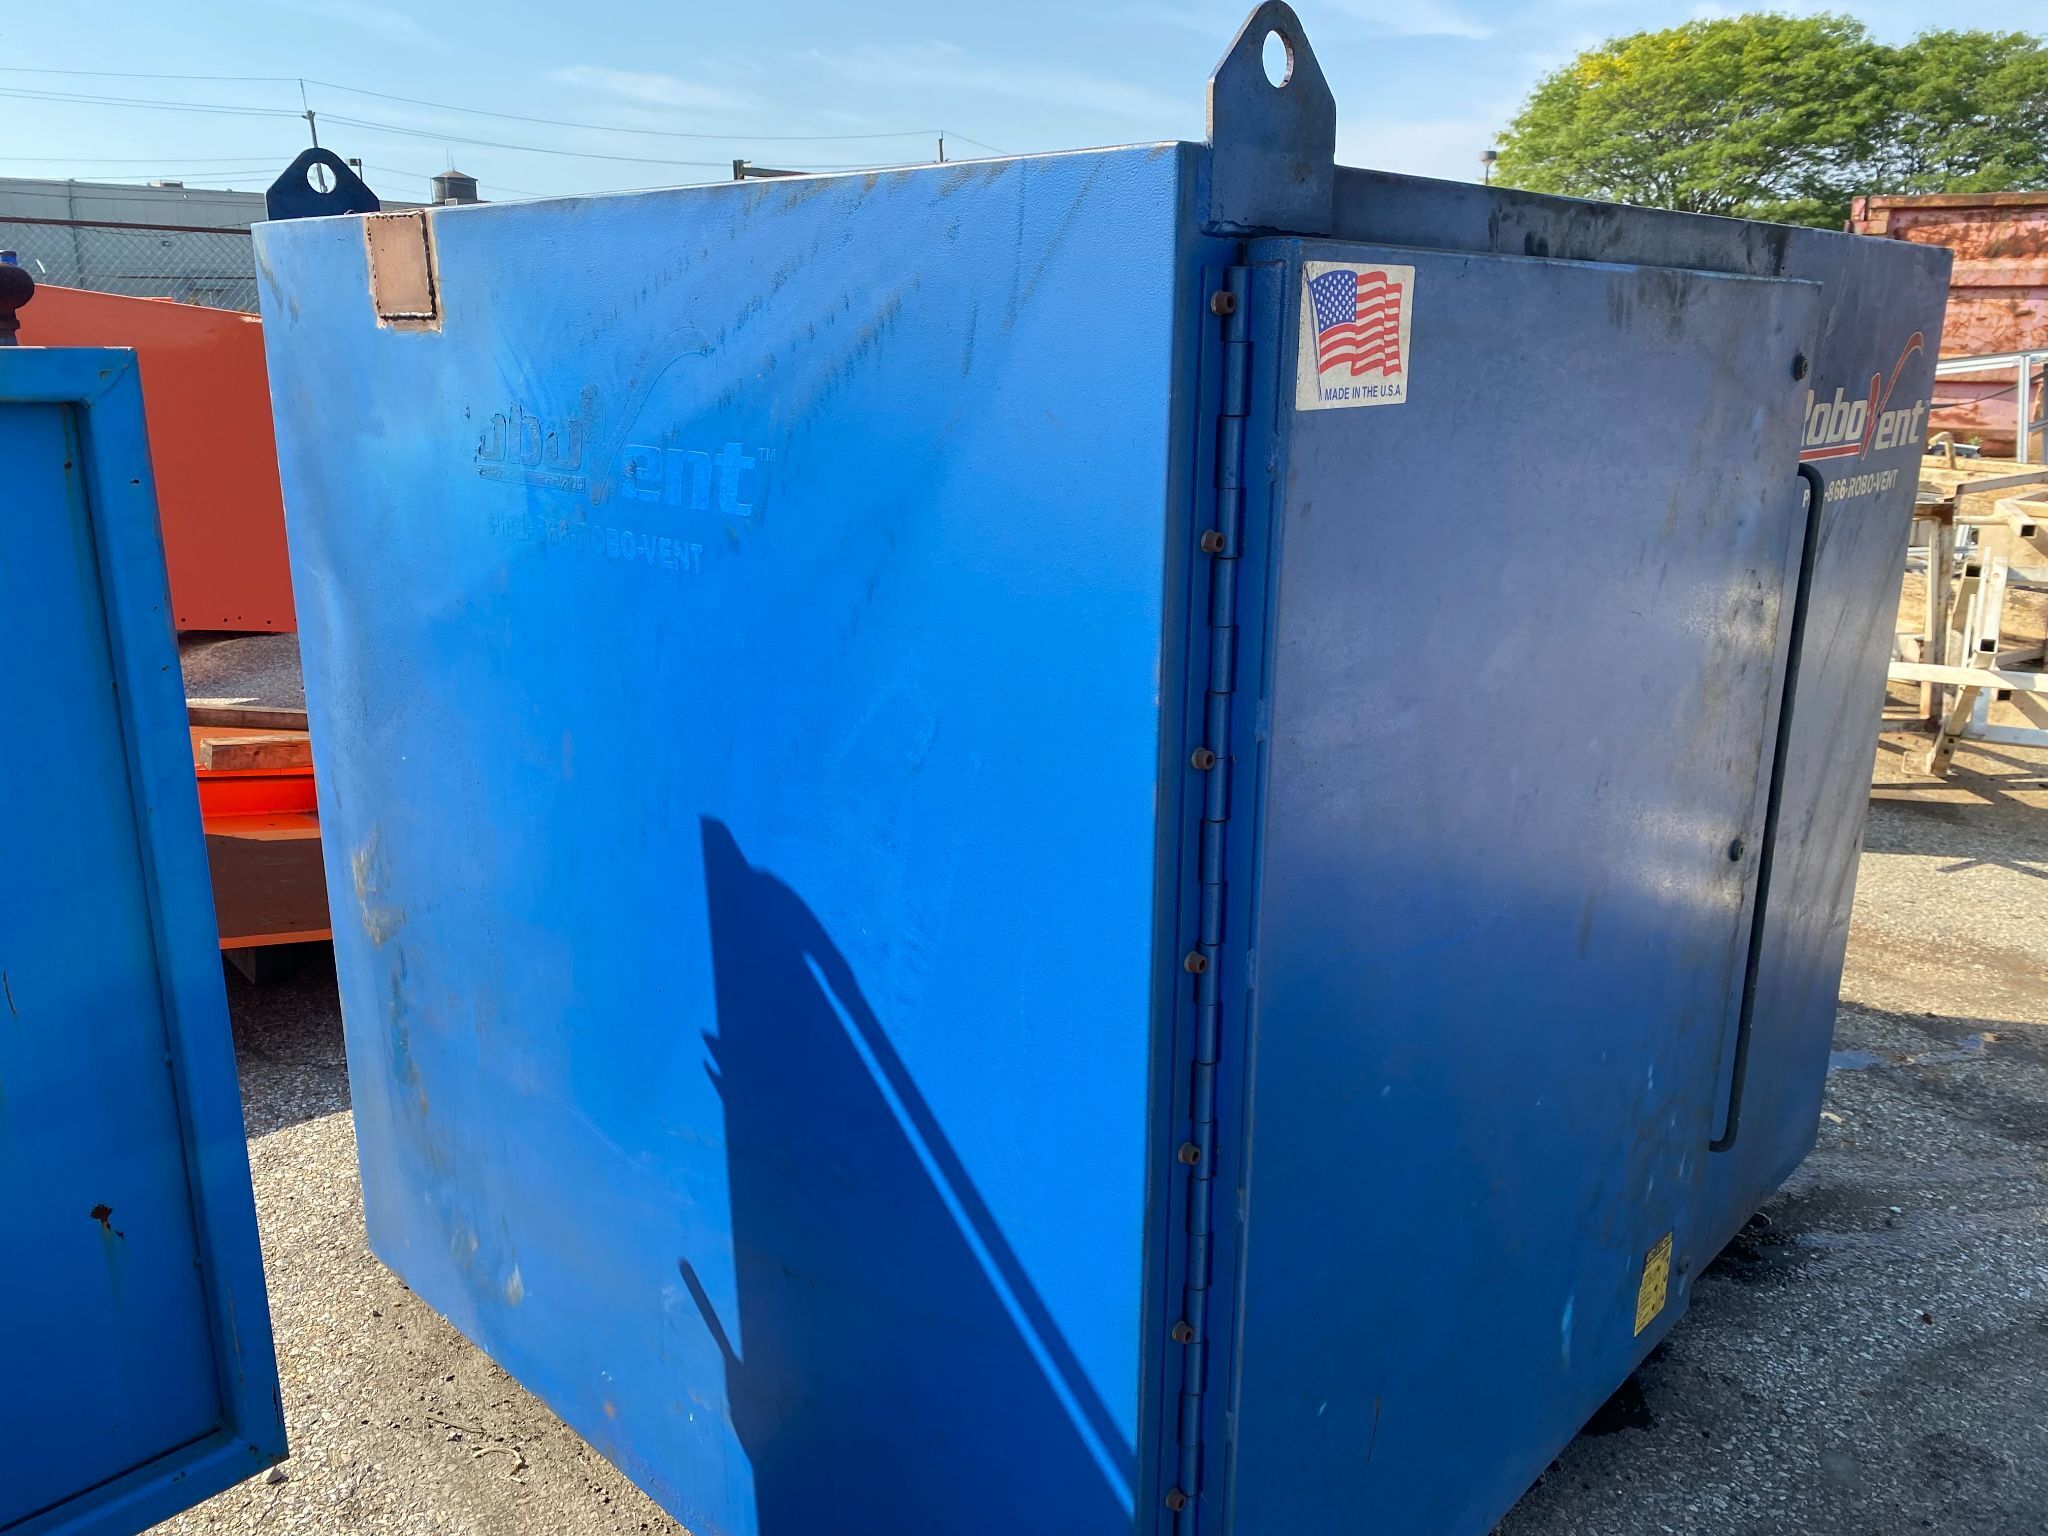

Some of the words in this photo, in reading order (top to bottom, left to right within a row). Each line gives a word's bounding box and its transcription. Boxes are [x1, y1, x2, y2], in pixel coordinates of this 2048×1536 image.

[1325, 387, 1350, 401] MADE
[1352, 386, 1360, 399] IN
[1362, 385, 1378, 398] THE
[1380, 383, 1403, 397] U.S.A.
